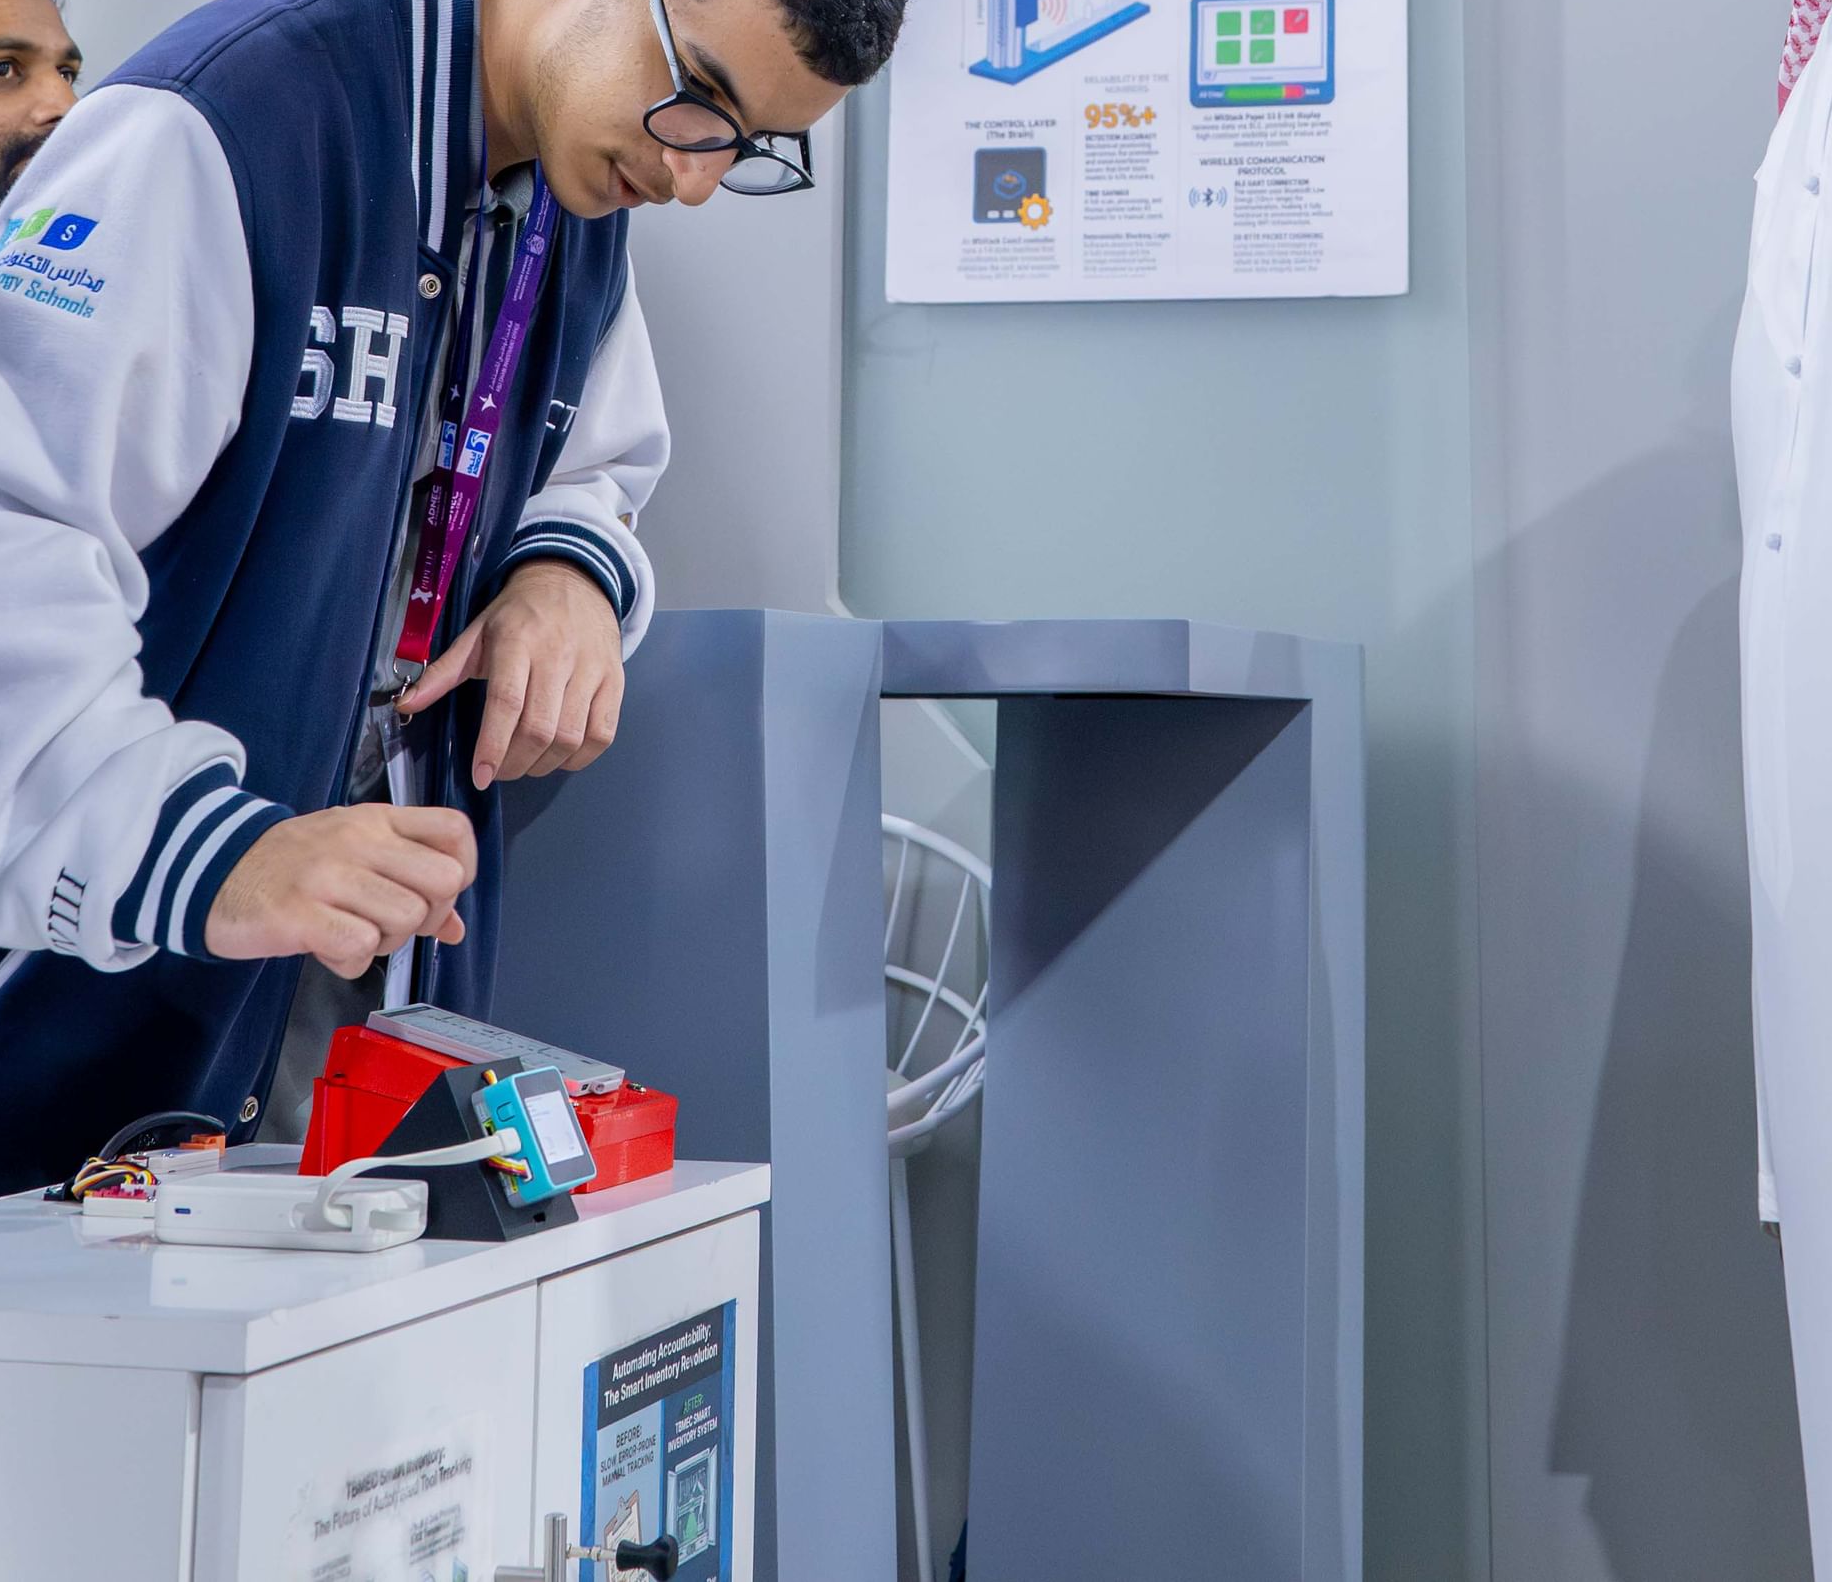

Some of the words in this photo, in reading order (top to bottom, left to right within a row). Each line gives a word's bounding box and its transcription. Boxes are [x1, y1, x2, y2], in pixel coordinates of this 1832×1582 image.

[1084, 103, 1157, 129] 95%+
[25, 279, 95, 318] Schools
[48, 266, 105, 293] مدارس
[427, 484, 442, 526] ADNEC
[612, 1348, 657, 1382] Automating
[657, 1323, 712, 1360] Accountability:
[604, 1389, 620, 1409] The
[620, 1378, 644, 1401] Smart
[644, 1360, 680, 1390] Inventory
[680, 1342, 718, 1373] Revolution
[616, 1424, 642, 1449] BEFORE:
[667, 1428, 697, 1454] INVENTORY
[697, 1416, 718, 1437] SYSTEM
[674, 1414, 693, 1434] TBMEC
[693, 1405, 711, 1424] SMART
[618, 1434, 657, 1464] ERROR-PRONE
[602, 1466, 626, 1488] MANUAL
[627, 1450, 655, 1475] TRACKING
